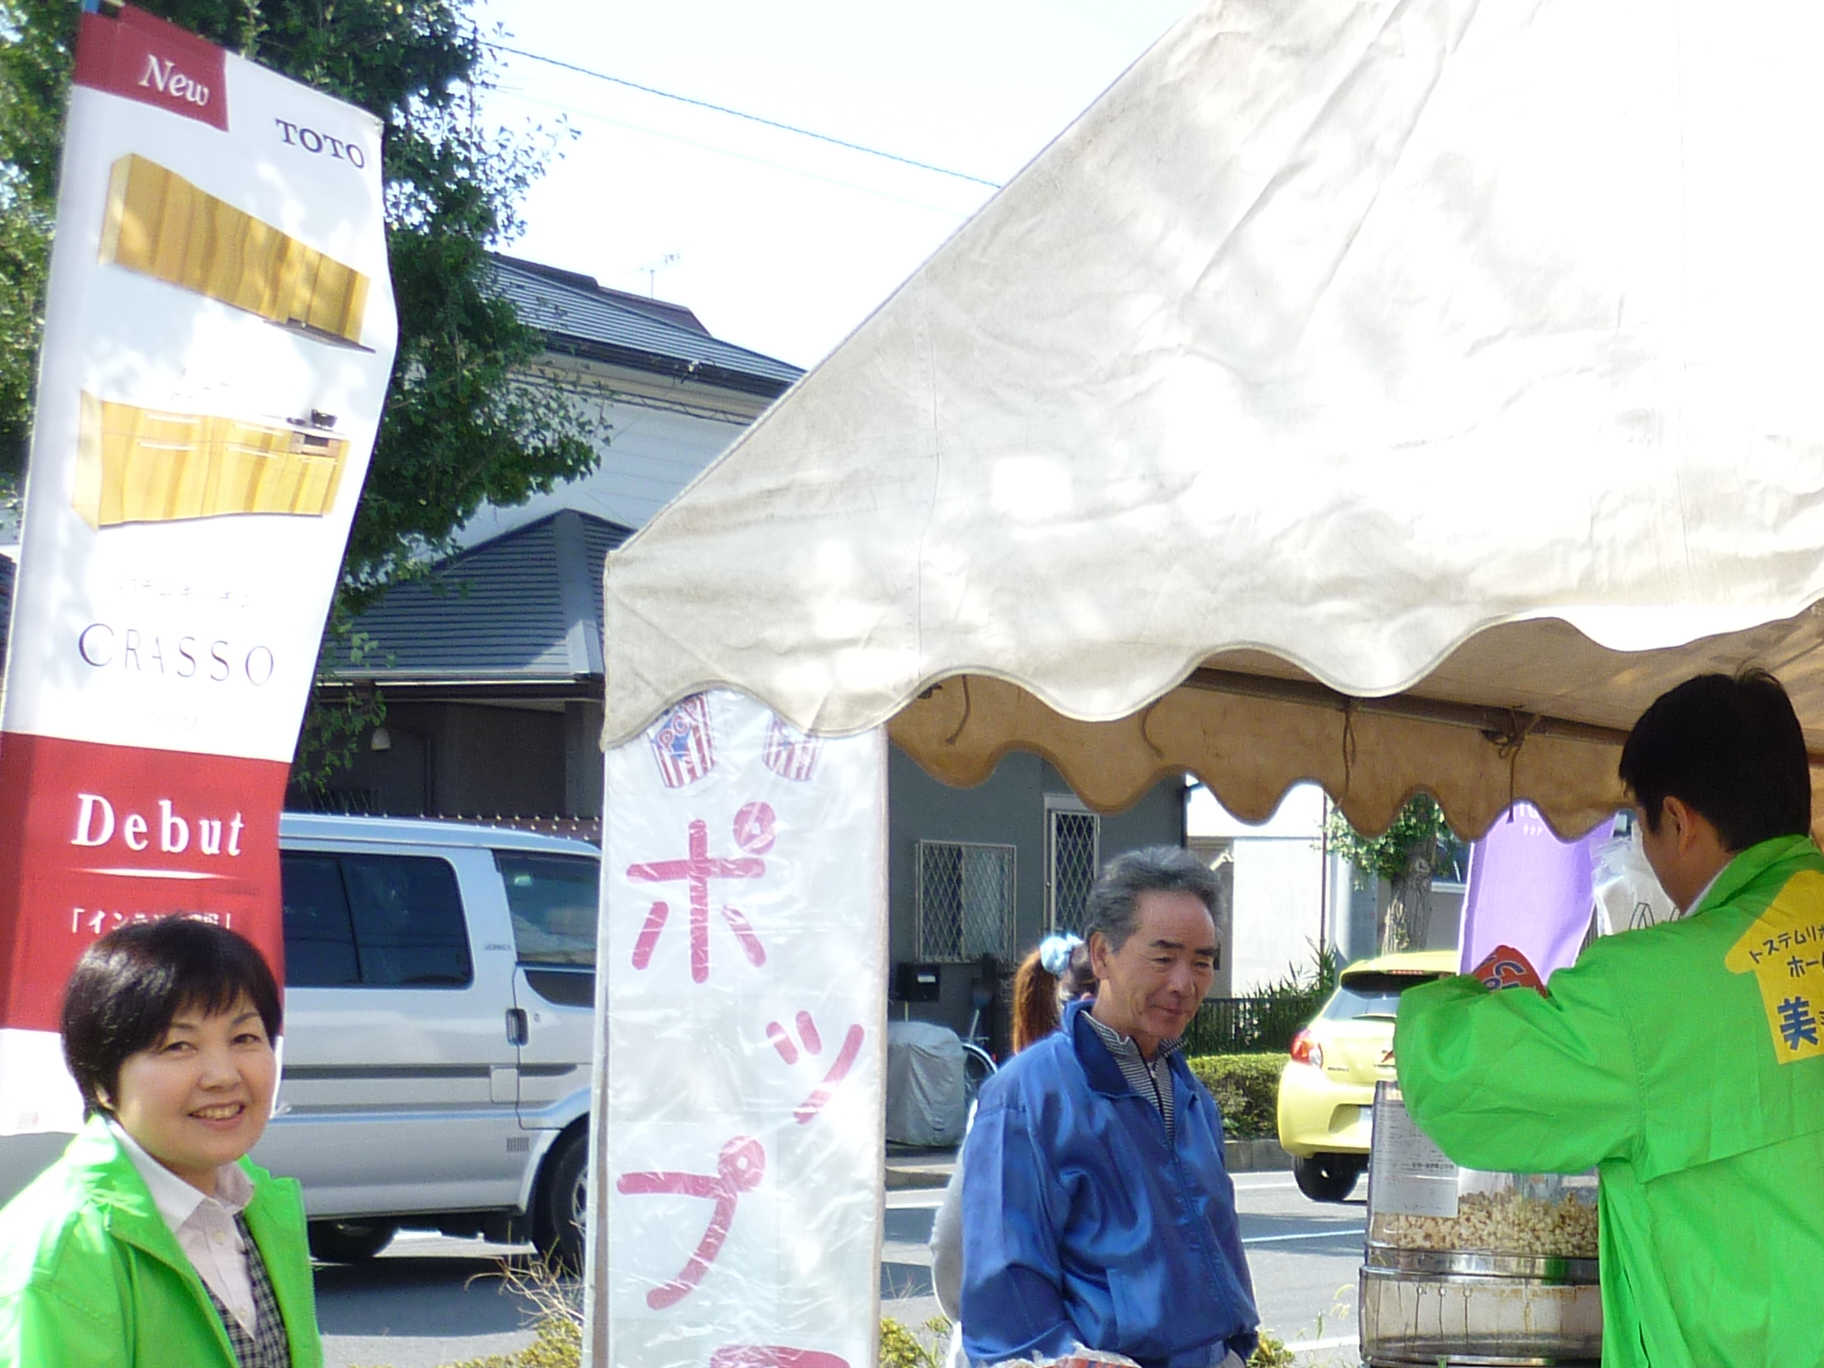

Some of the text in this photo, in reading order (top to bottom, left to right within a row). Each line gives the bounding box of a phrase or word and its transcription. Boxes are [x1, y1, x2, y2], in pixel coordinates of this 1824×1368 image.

[138, 53, 212, 108] New
[275, 117, 367, 170] TOTO
[78, 622, 275, 688] CRASSO
[71, 793, 245, 858] Debut
